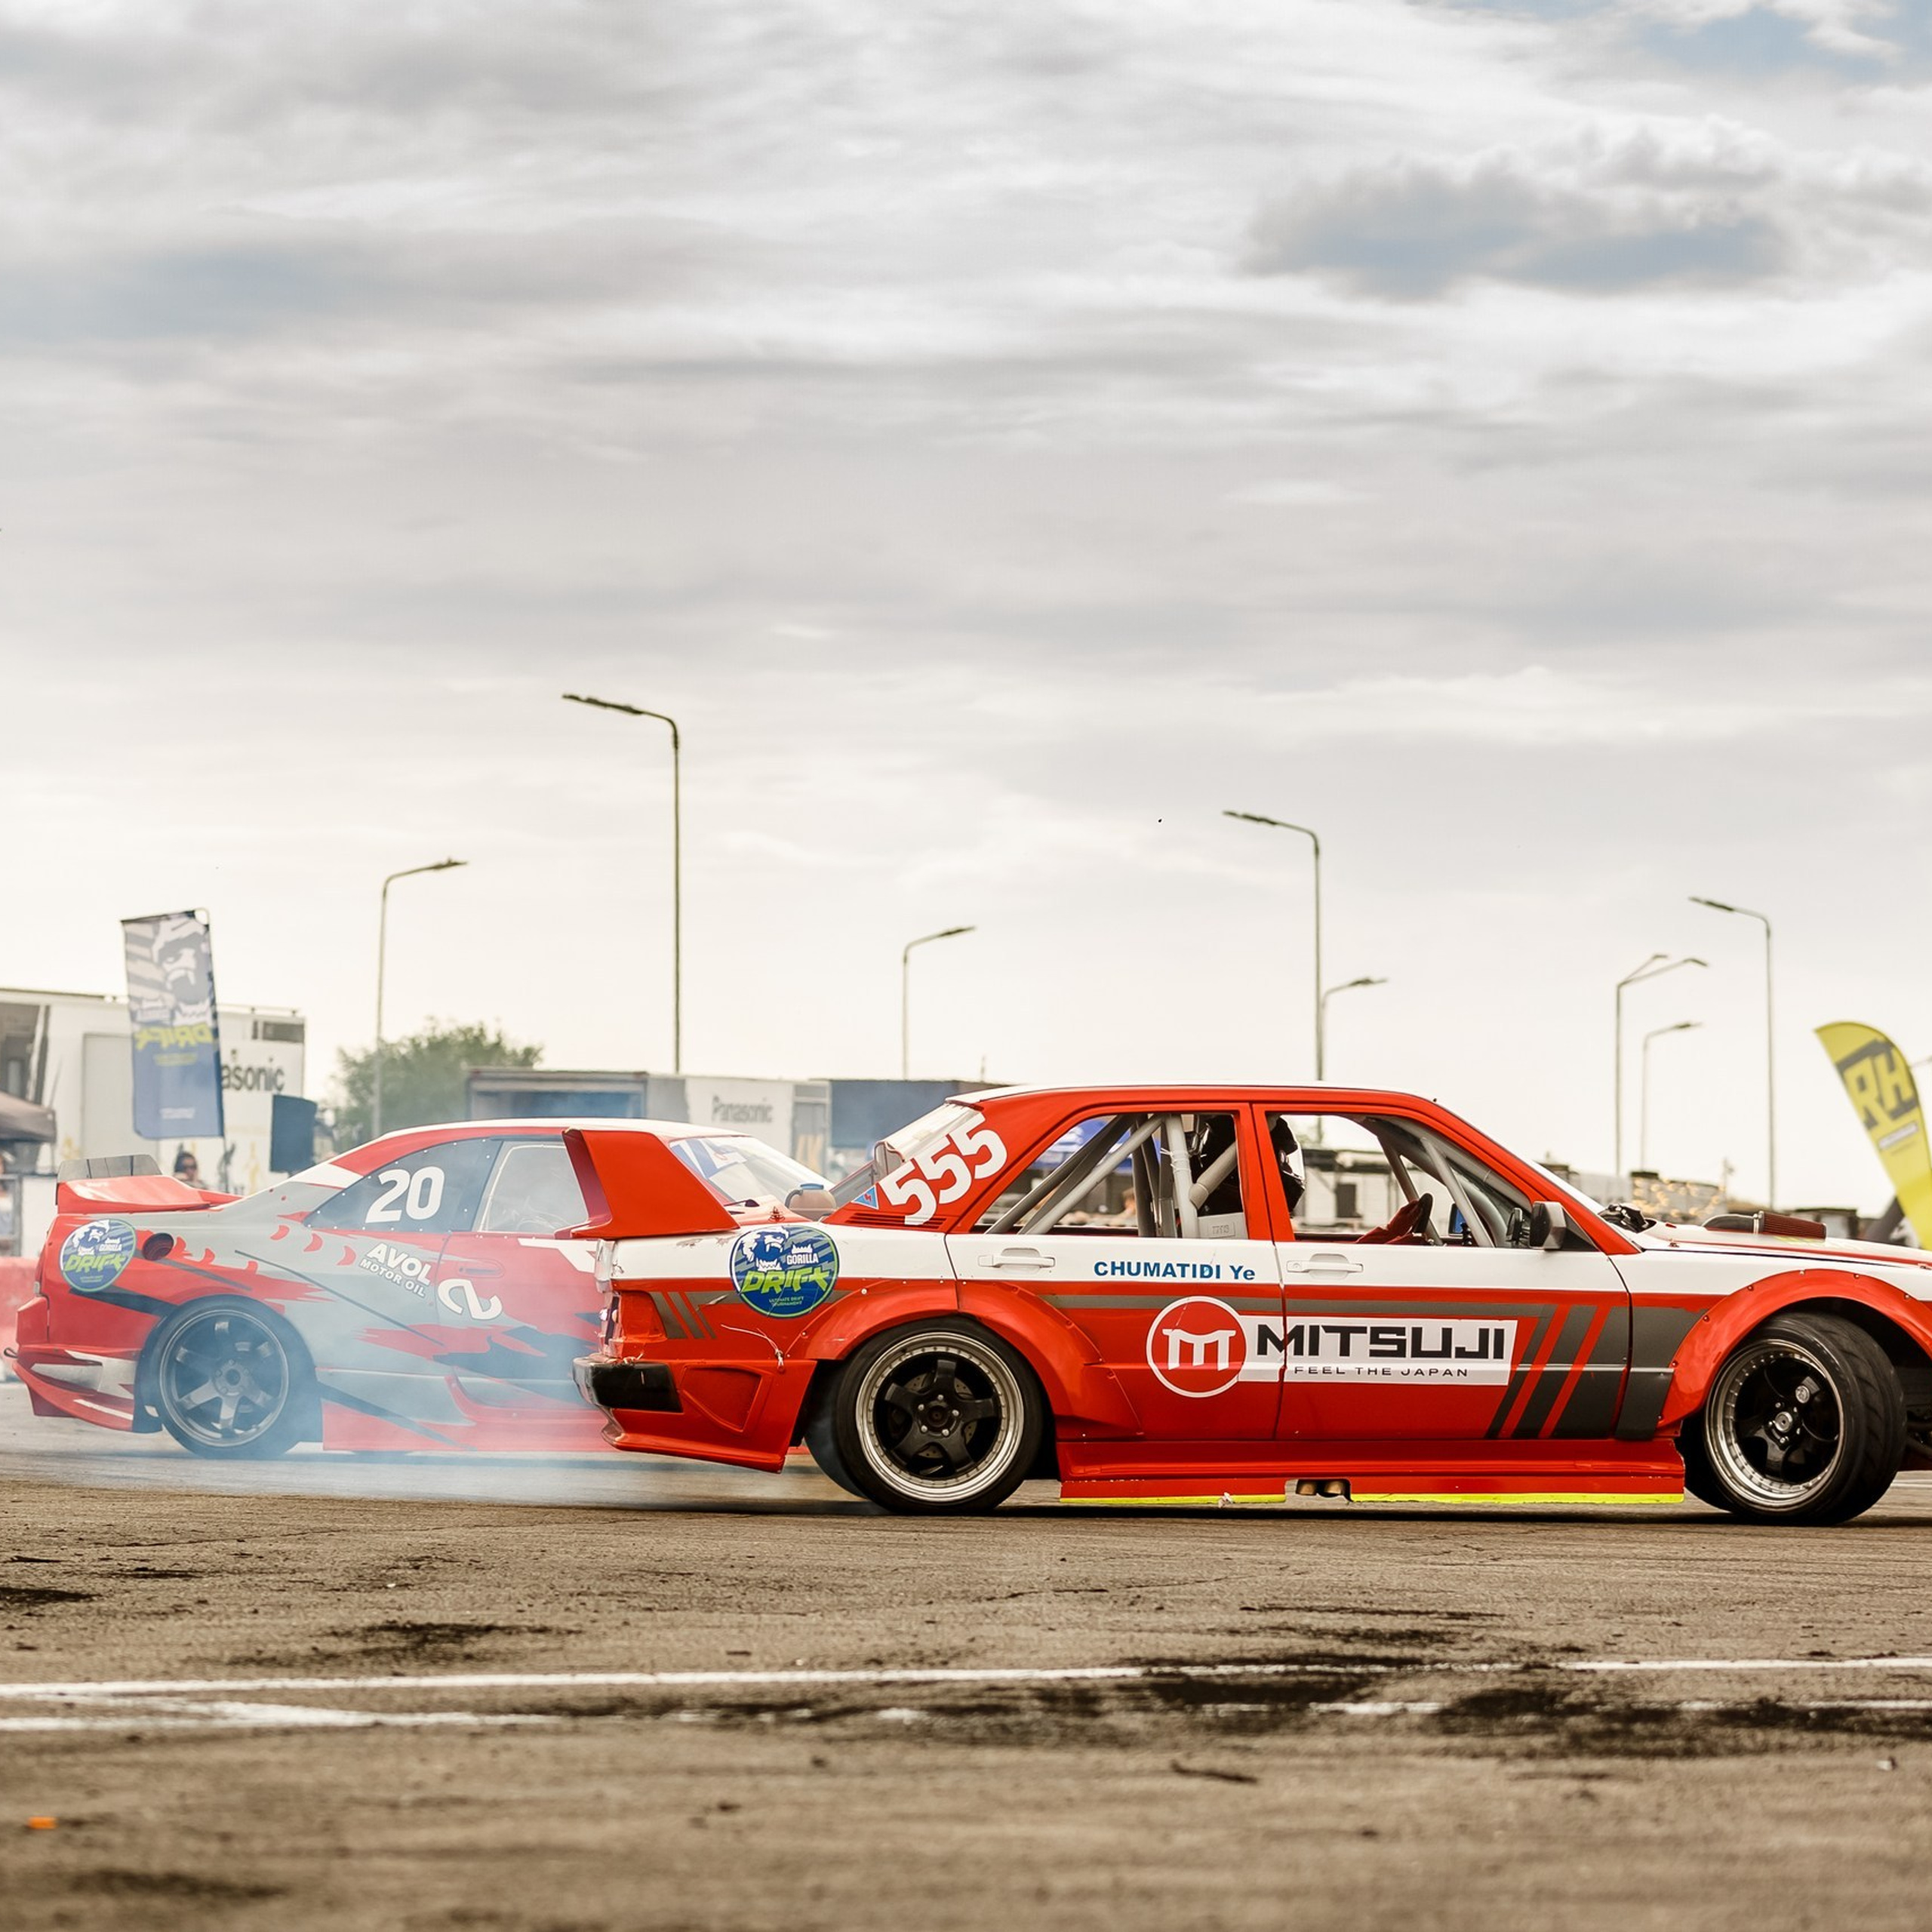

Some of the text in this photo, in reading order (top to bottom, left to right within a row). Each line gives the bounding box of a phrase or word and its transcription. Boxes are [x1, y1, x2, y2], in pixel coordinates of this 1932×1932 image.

[878, 1112, 1008, 1226] 555
[365, 1166, 445, 1223] 20
[63, 1254, 126, 1273] DRIFT
[367, 1242, 432, 1286] AVOL
[786, 1253, 819, 1265] GORILLA
[1094, 1261, 1256, 1280] CHUMATIDI Ye
[358, 1258, 426, 1298] MOTOR OIL
[741, 1266, 829, 1294] DRIFT
[1257, 1324, 1505, 1359] MITSUJI
[1294, 1366, 1468, 1377] FEEL THE JAPAN
